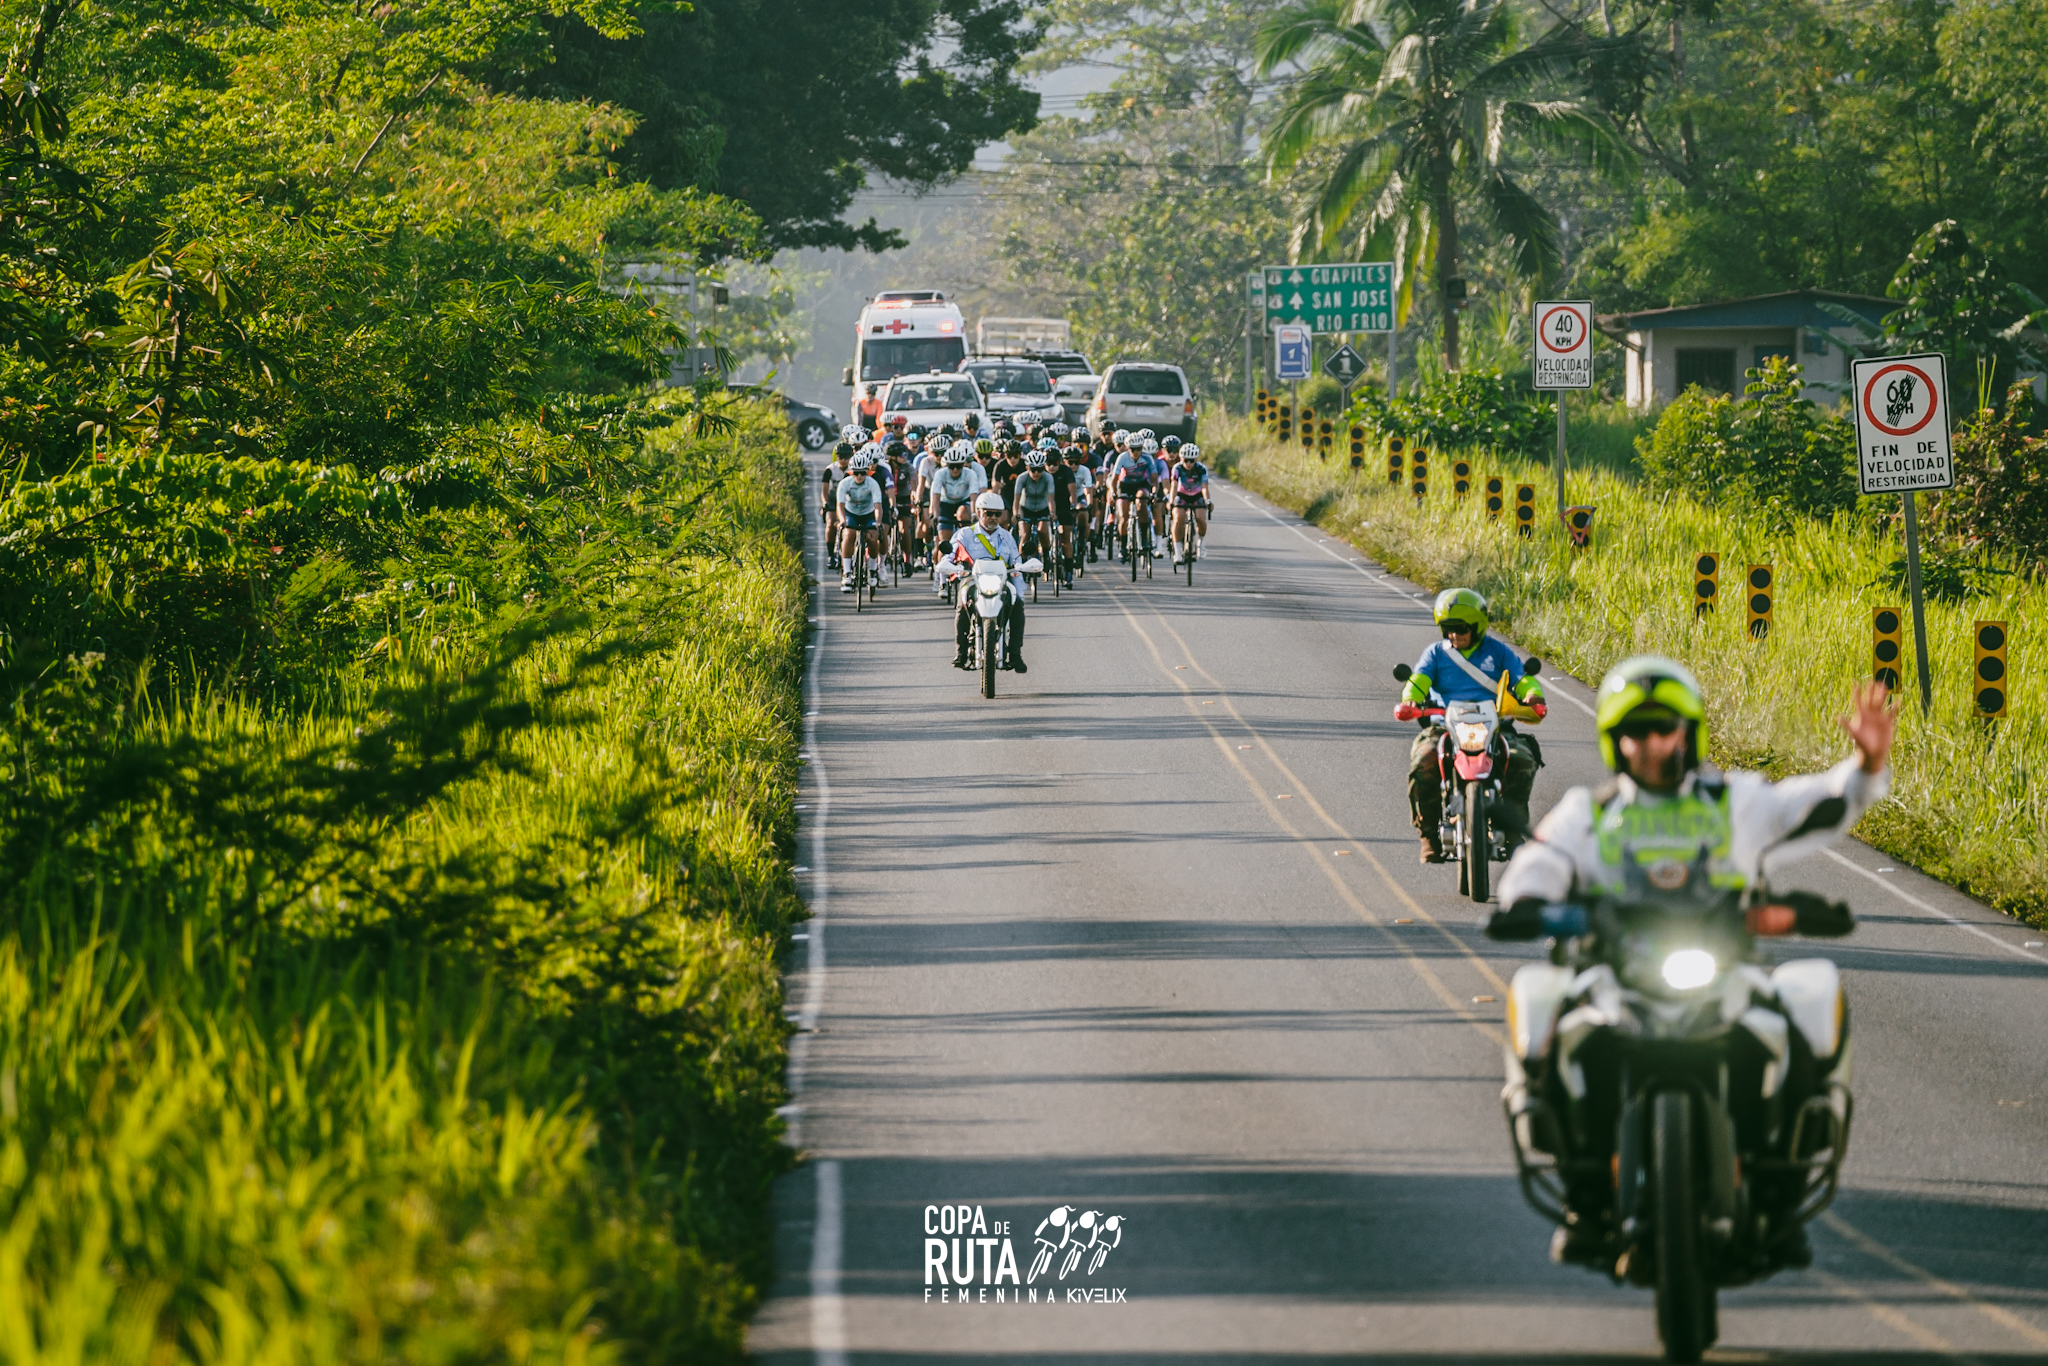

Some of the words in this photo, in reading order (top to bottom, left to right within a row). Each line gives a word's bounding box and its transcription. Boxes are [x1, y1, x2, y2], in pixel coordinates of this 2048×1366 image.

[1311, 267, 1387, 285] GUAPILES
[1312, 291, 1342, 309] SAN
[1350, 289, 1388, 308] JOSE
[1316, 314, 1343, 332] RIO
[1350, 312, 1388, 330] FRIO
[1555, 314, 1573, 333] 40
[1555, 336, 1572, 346] KPH
[1537, 358, 1589, 371] VELOCIDAD
[1538, 372, 1588, 385] RESTRINGIDA
[1871, 444, 1899, 457] FIN
[1917, 441, 1937, 454] DE
[1867, 456, 1945, 474] VELOCIDAD
[1868, 473, 1946, 488] RESTRINGIDA
